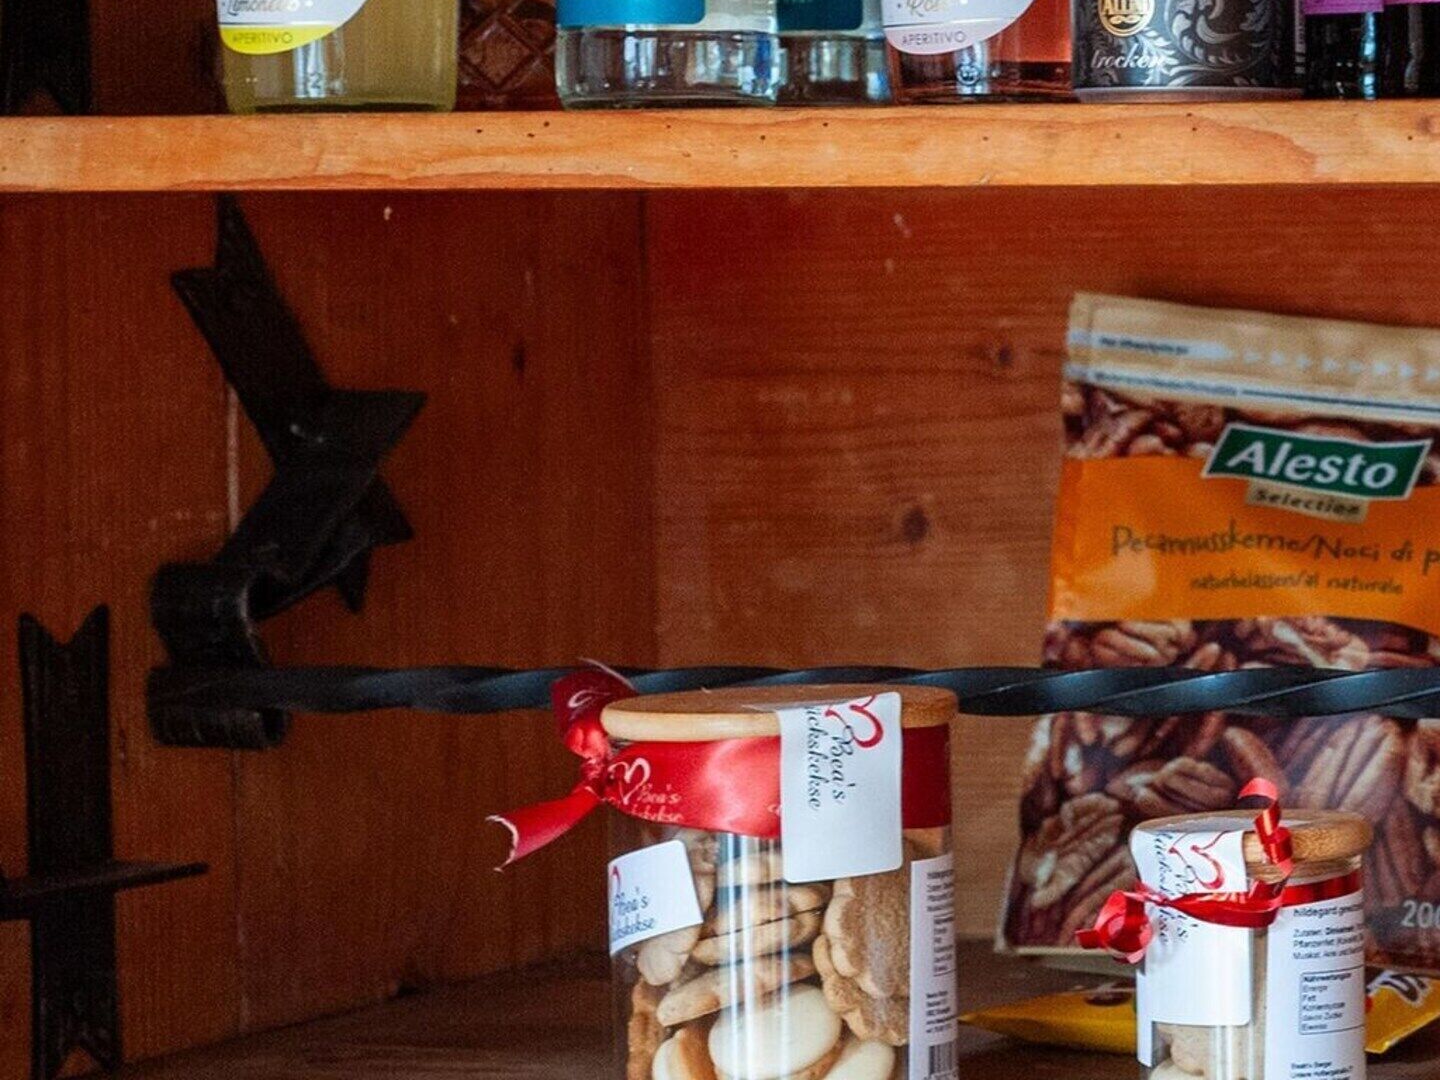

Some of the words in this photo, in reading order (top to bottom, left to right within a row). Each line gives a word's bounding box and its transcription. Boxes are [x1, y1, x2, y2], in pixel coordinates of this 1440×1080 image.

[902, 30, 967, 47] APERITIVO
[1228, 439, 1397, 490] Alesto
[1255, 488, 1361, 516] Selection
[1390, 541, 1414, 563] di
